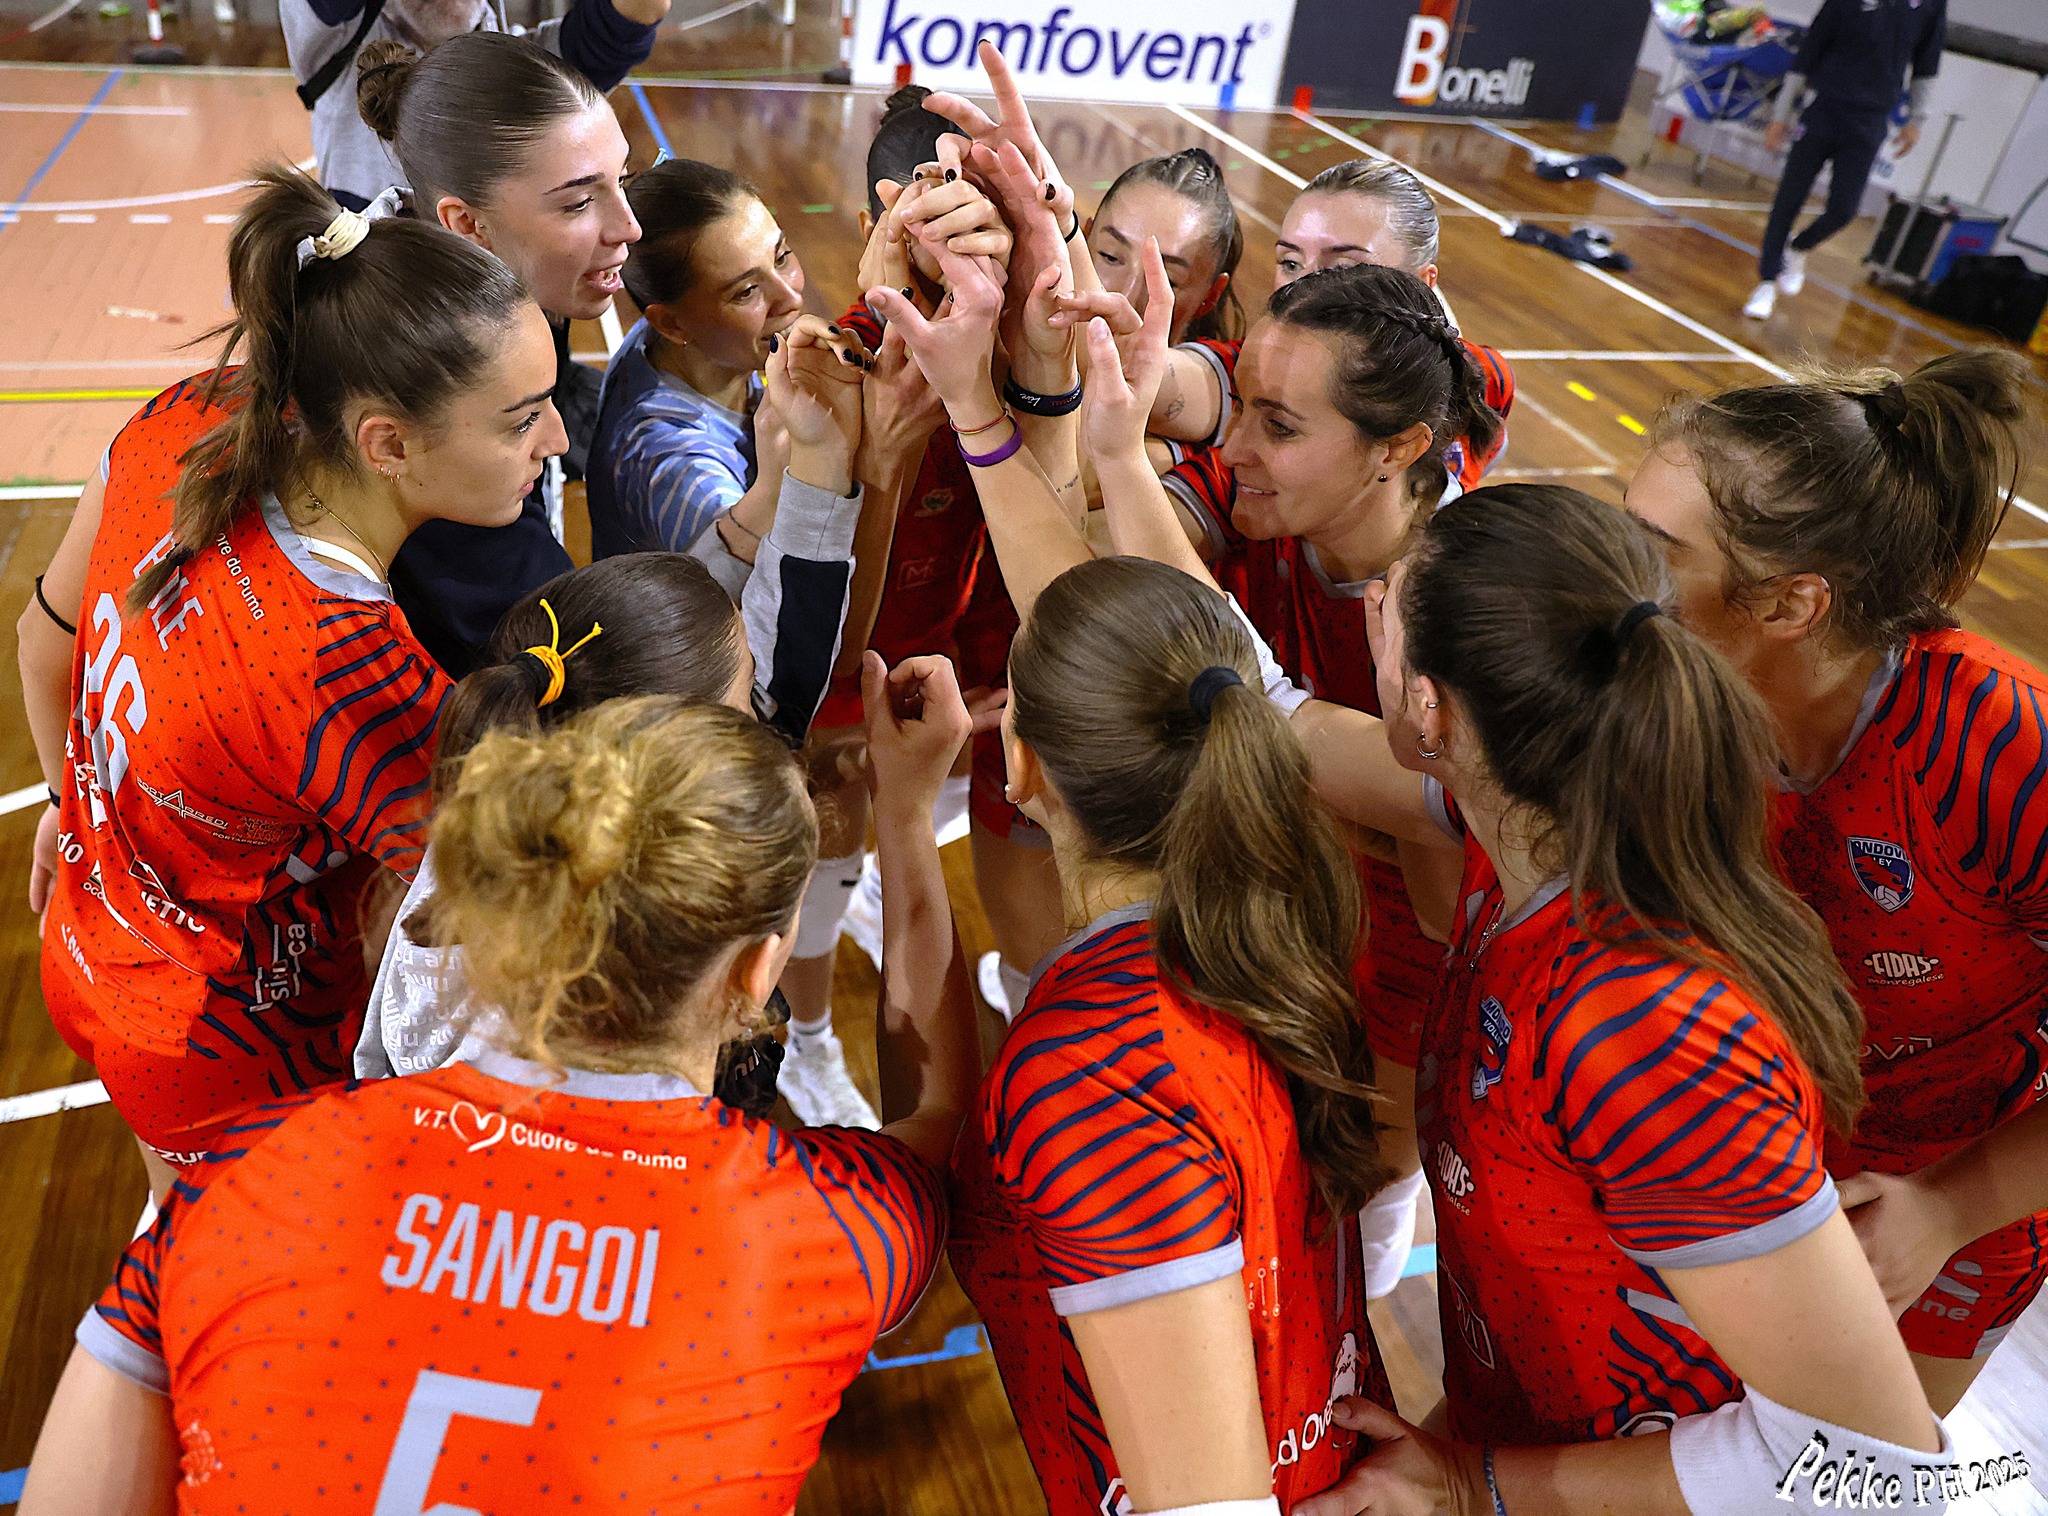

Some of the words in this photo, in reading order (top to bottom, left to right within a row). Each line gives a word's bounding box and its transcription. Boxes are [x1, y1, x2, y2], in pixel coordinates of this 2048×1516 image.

[876, 0, 1254, 83] komfovent
[1393, 14, 1535, 105] Bonelli
[226, 557, 242, 577] da
[236, 575, 265, 621] Puma
[1867, 972, 1945, 988] monregalese
[413, 1106, 447, 1130] V.T.
[380, 1192, 660, 1329] SANGOI
